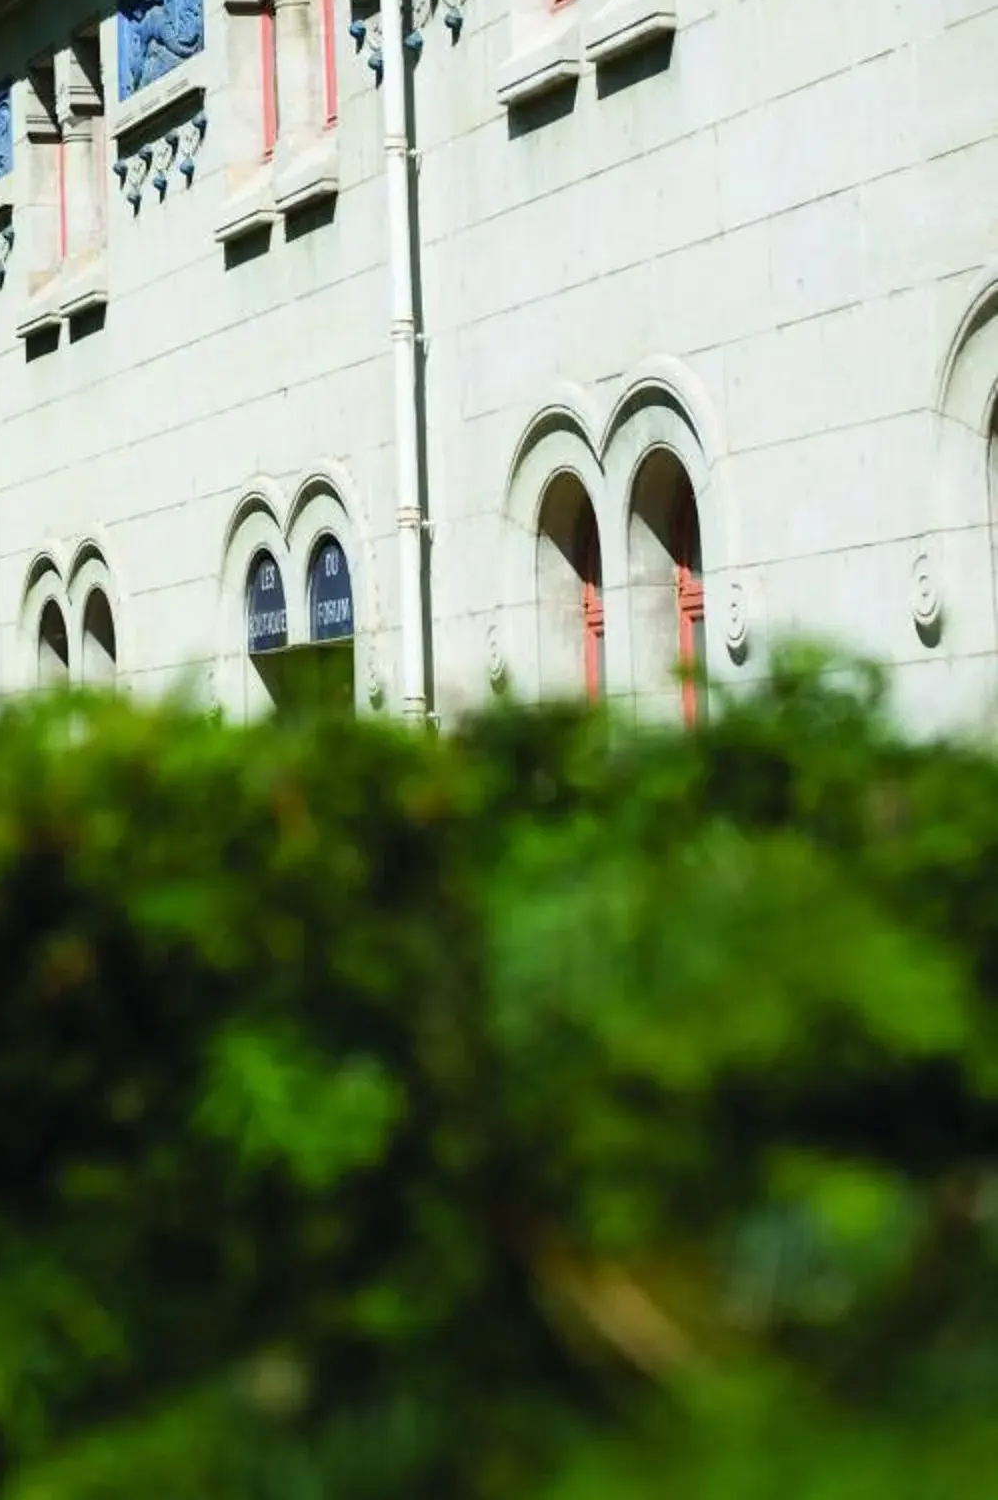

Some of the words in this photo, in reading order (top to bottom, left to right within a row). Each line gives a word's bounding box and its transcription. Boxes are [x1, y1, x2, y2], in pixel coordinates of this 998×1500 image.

[261, 565, 275, 590] LES
[325, 553, 339, 577] DU
[317, 598, 350, 626] FORUM
